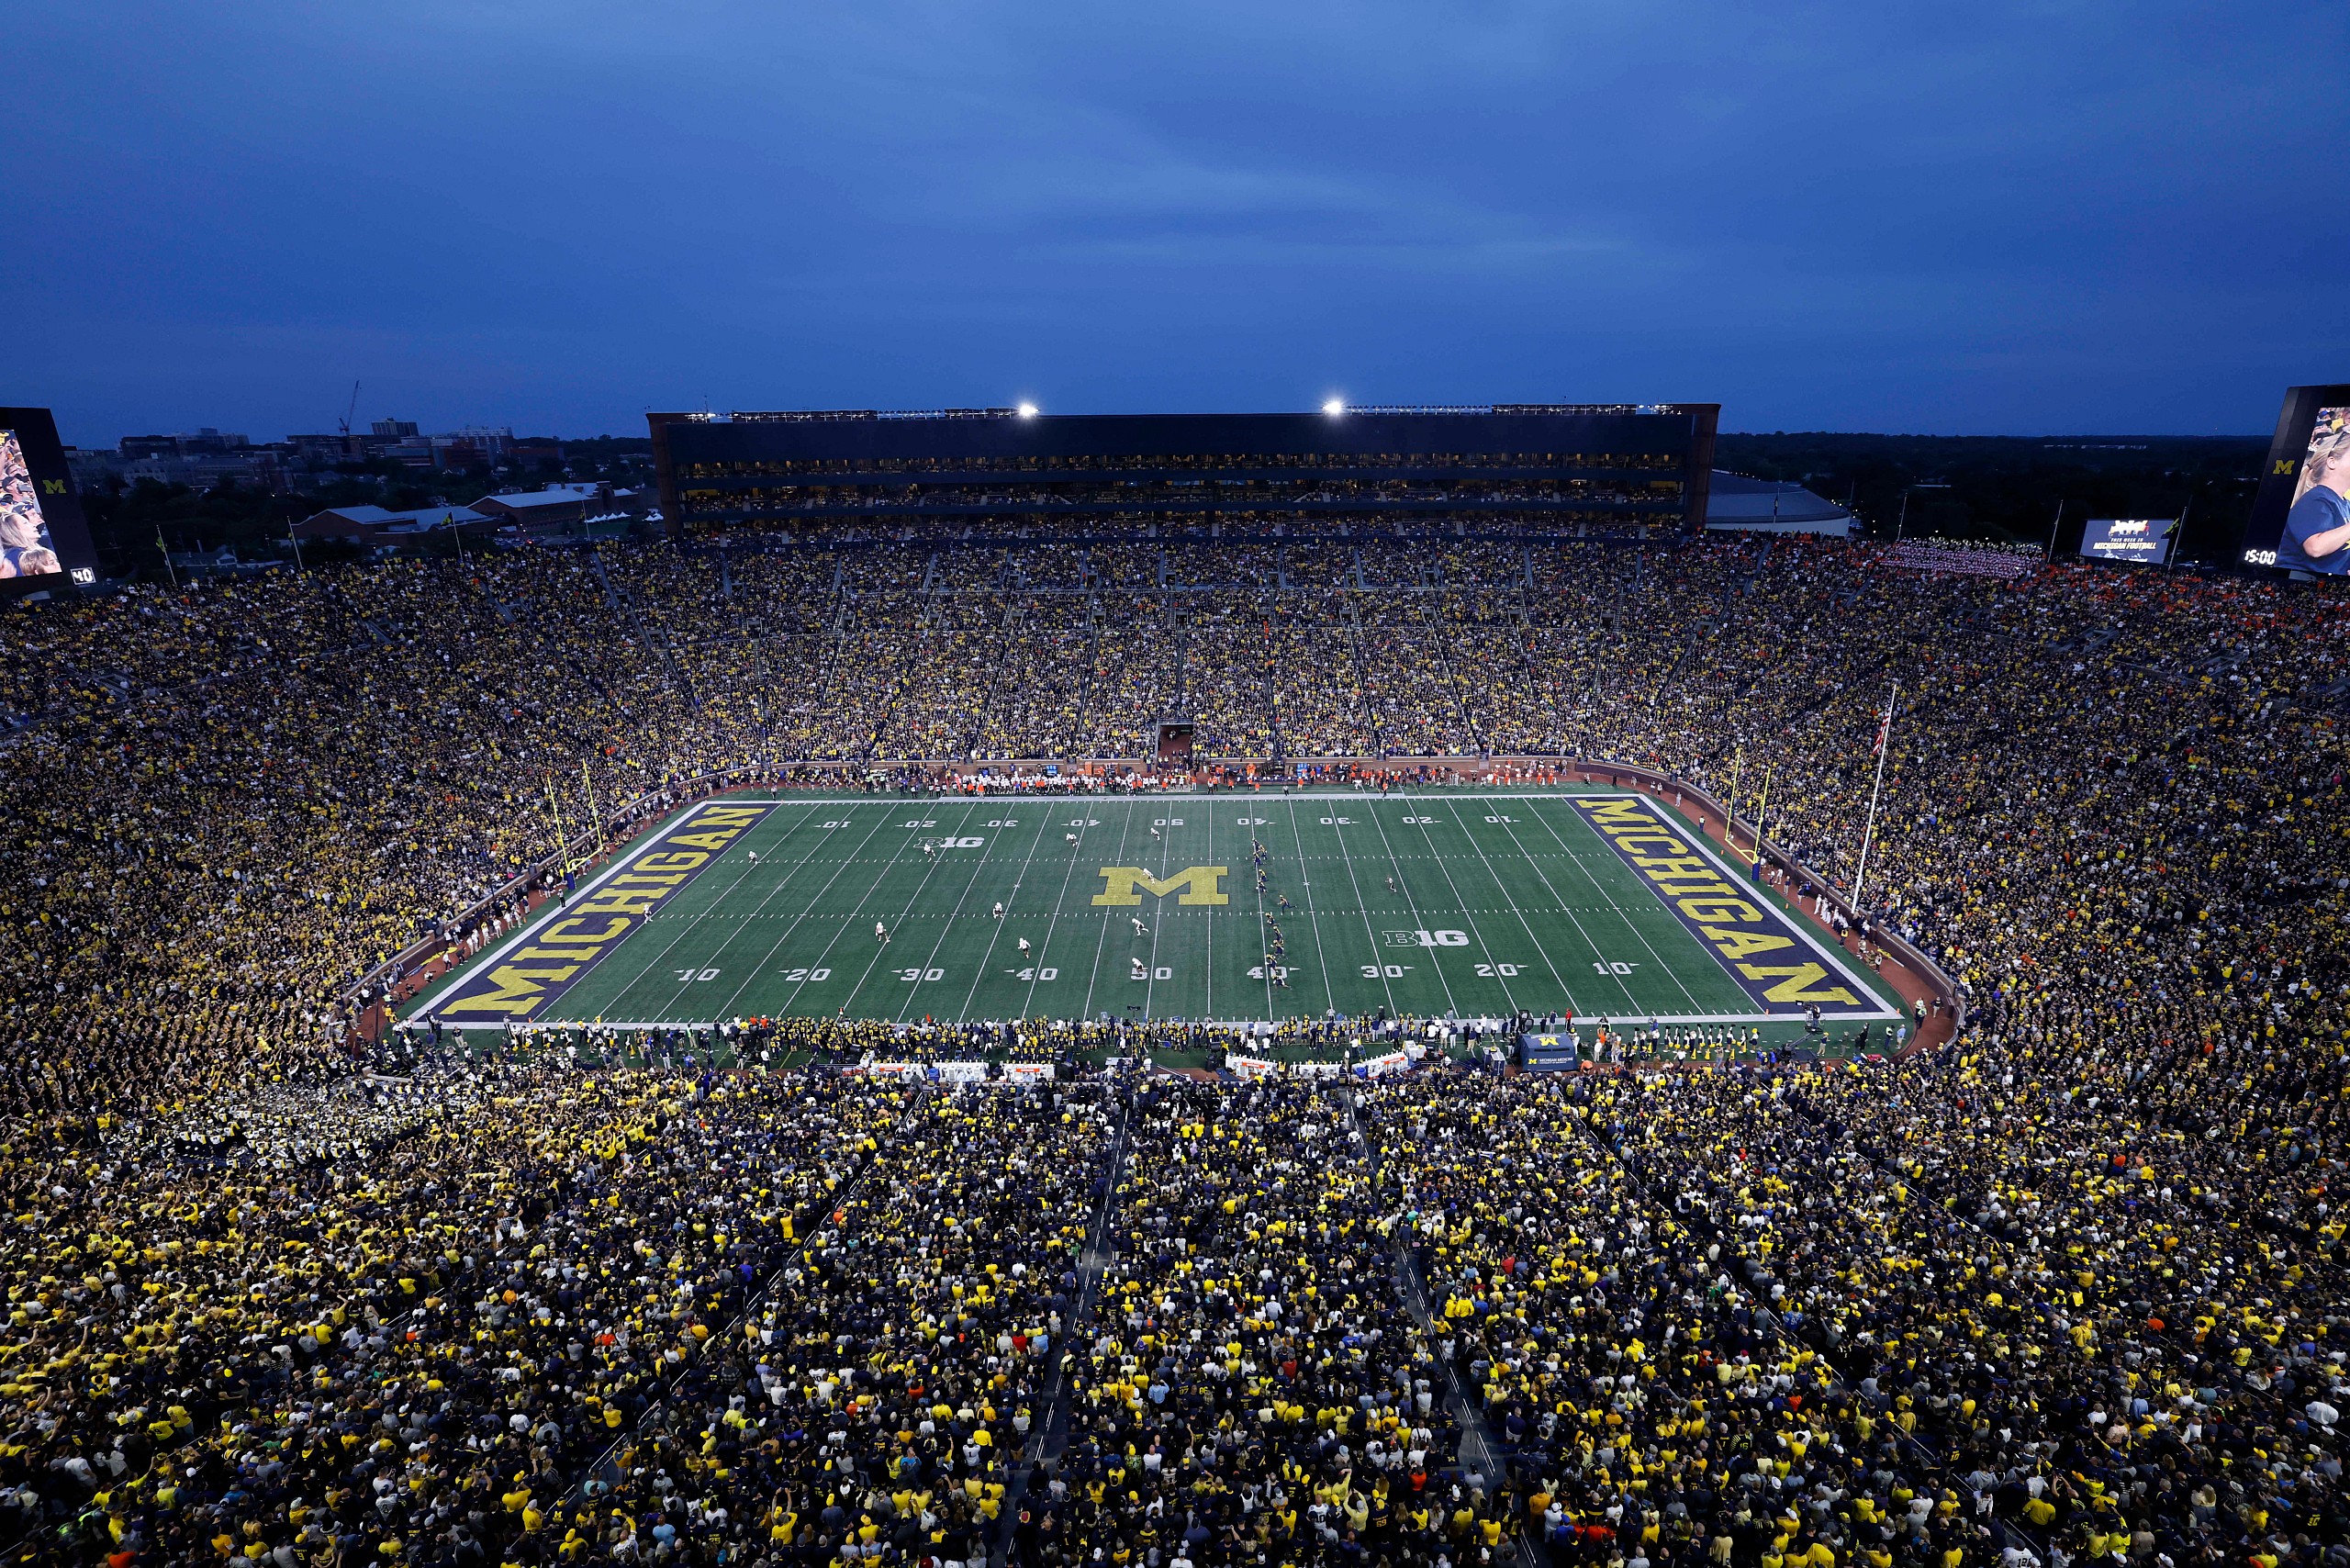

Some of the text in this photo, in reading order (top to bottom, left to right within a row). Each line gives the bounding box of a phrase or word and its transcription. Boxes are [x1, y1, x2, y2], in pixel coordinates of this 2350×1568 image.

[2273, 460, 2295, 475] M
[42, 479, 67, 495] M
[2244, 549, 2277, 566] 15:00
[73, 569, 93, 582] 40
[987, 820, 1018, 828] 30
[1154, 818, 1184, 826] 50
[1403, 816, 1434, 824] 20
[1484, 815, 1513, 823] 10
[1090, 866, 1229, 906] M
[1575, 799, 1862, 1006] MICHIGAN
[439, 806, 767, 1015] MICHIGAN
[678, 969, 721, 980] 10
[785, 969, 831, 980] 20
[901, 969, 945, 980] 30
[1016, 968, 1058, 980] 40
[1360, 965, 1404, 978] 30
[1473, 964, 1518, 977] 20
[1593, 962, 1633, 975] 10
